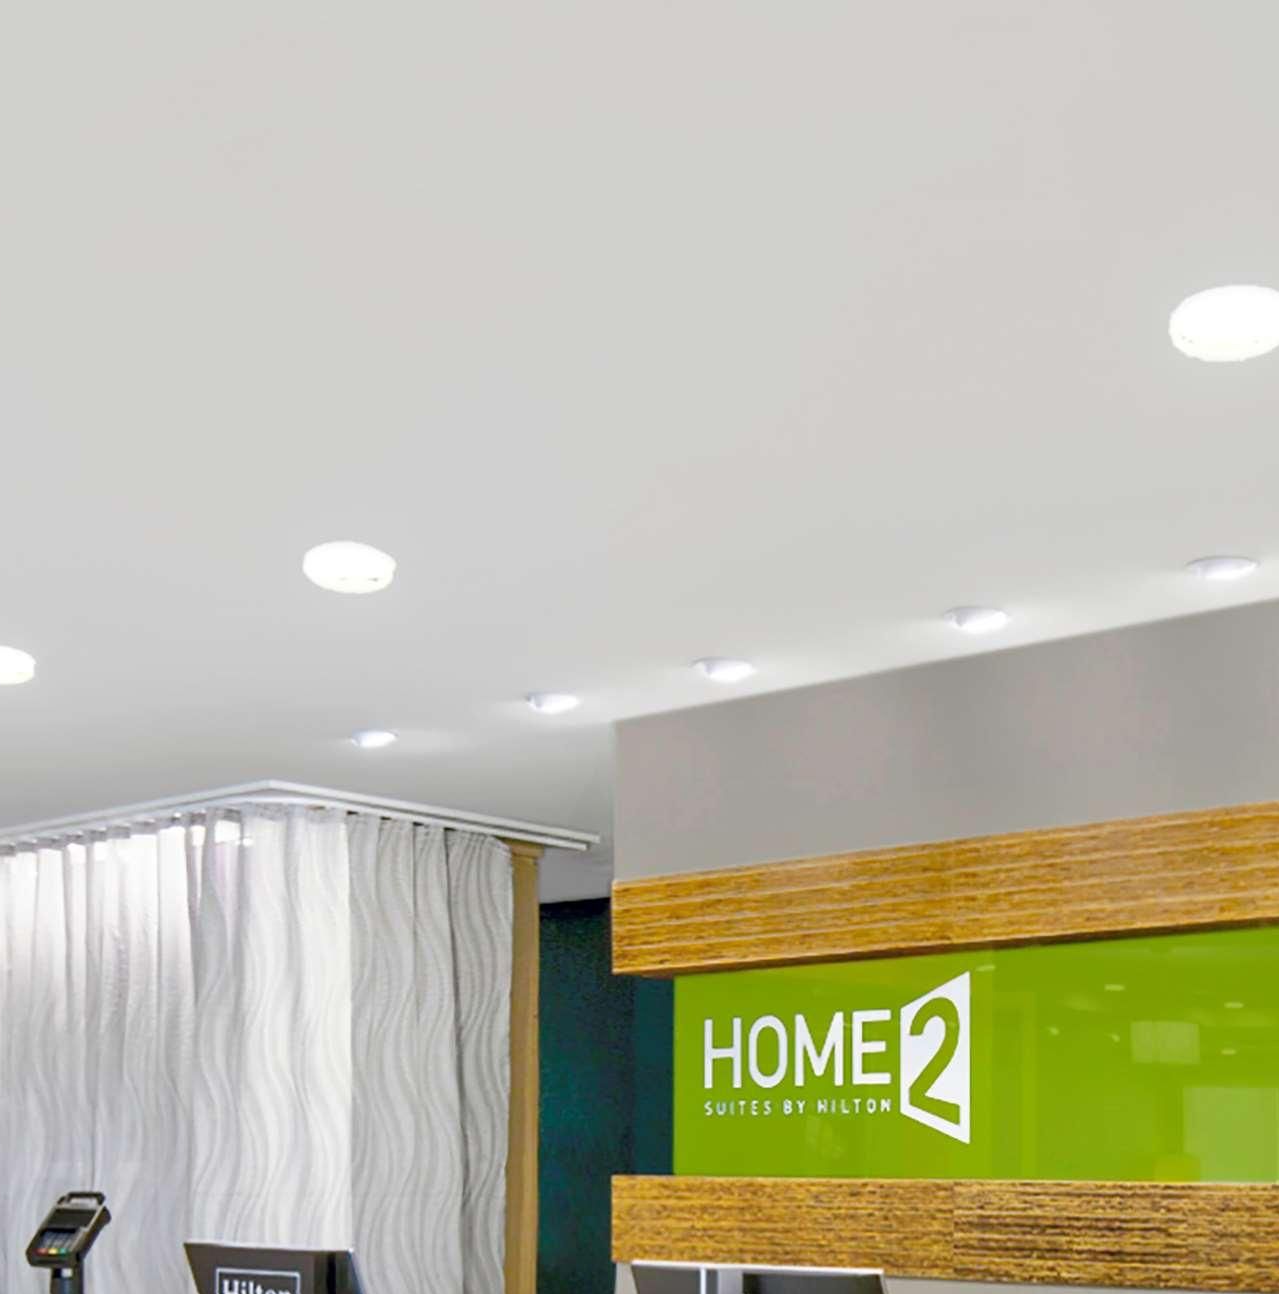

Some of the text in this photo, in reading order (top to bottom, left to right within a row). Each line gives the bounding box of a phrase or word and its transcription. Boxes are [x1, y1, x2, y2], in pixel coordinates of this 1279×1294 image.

[704, 996, 961, 1127] HOME 2
[704, 1098, 892, 1116] SUITES BY HILTON
